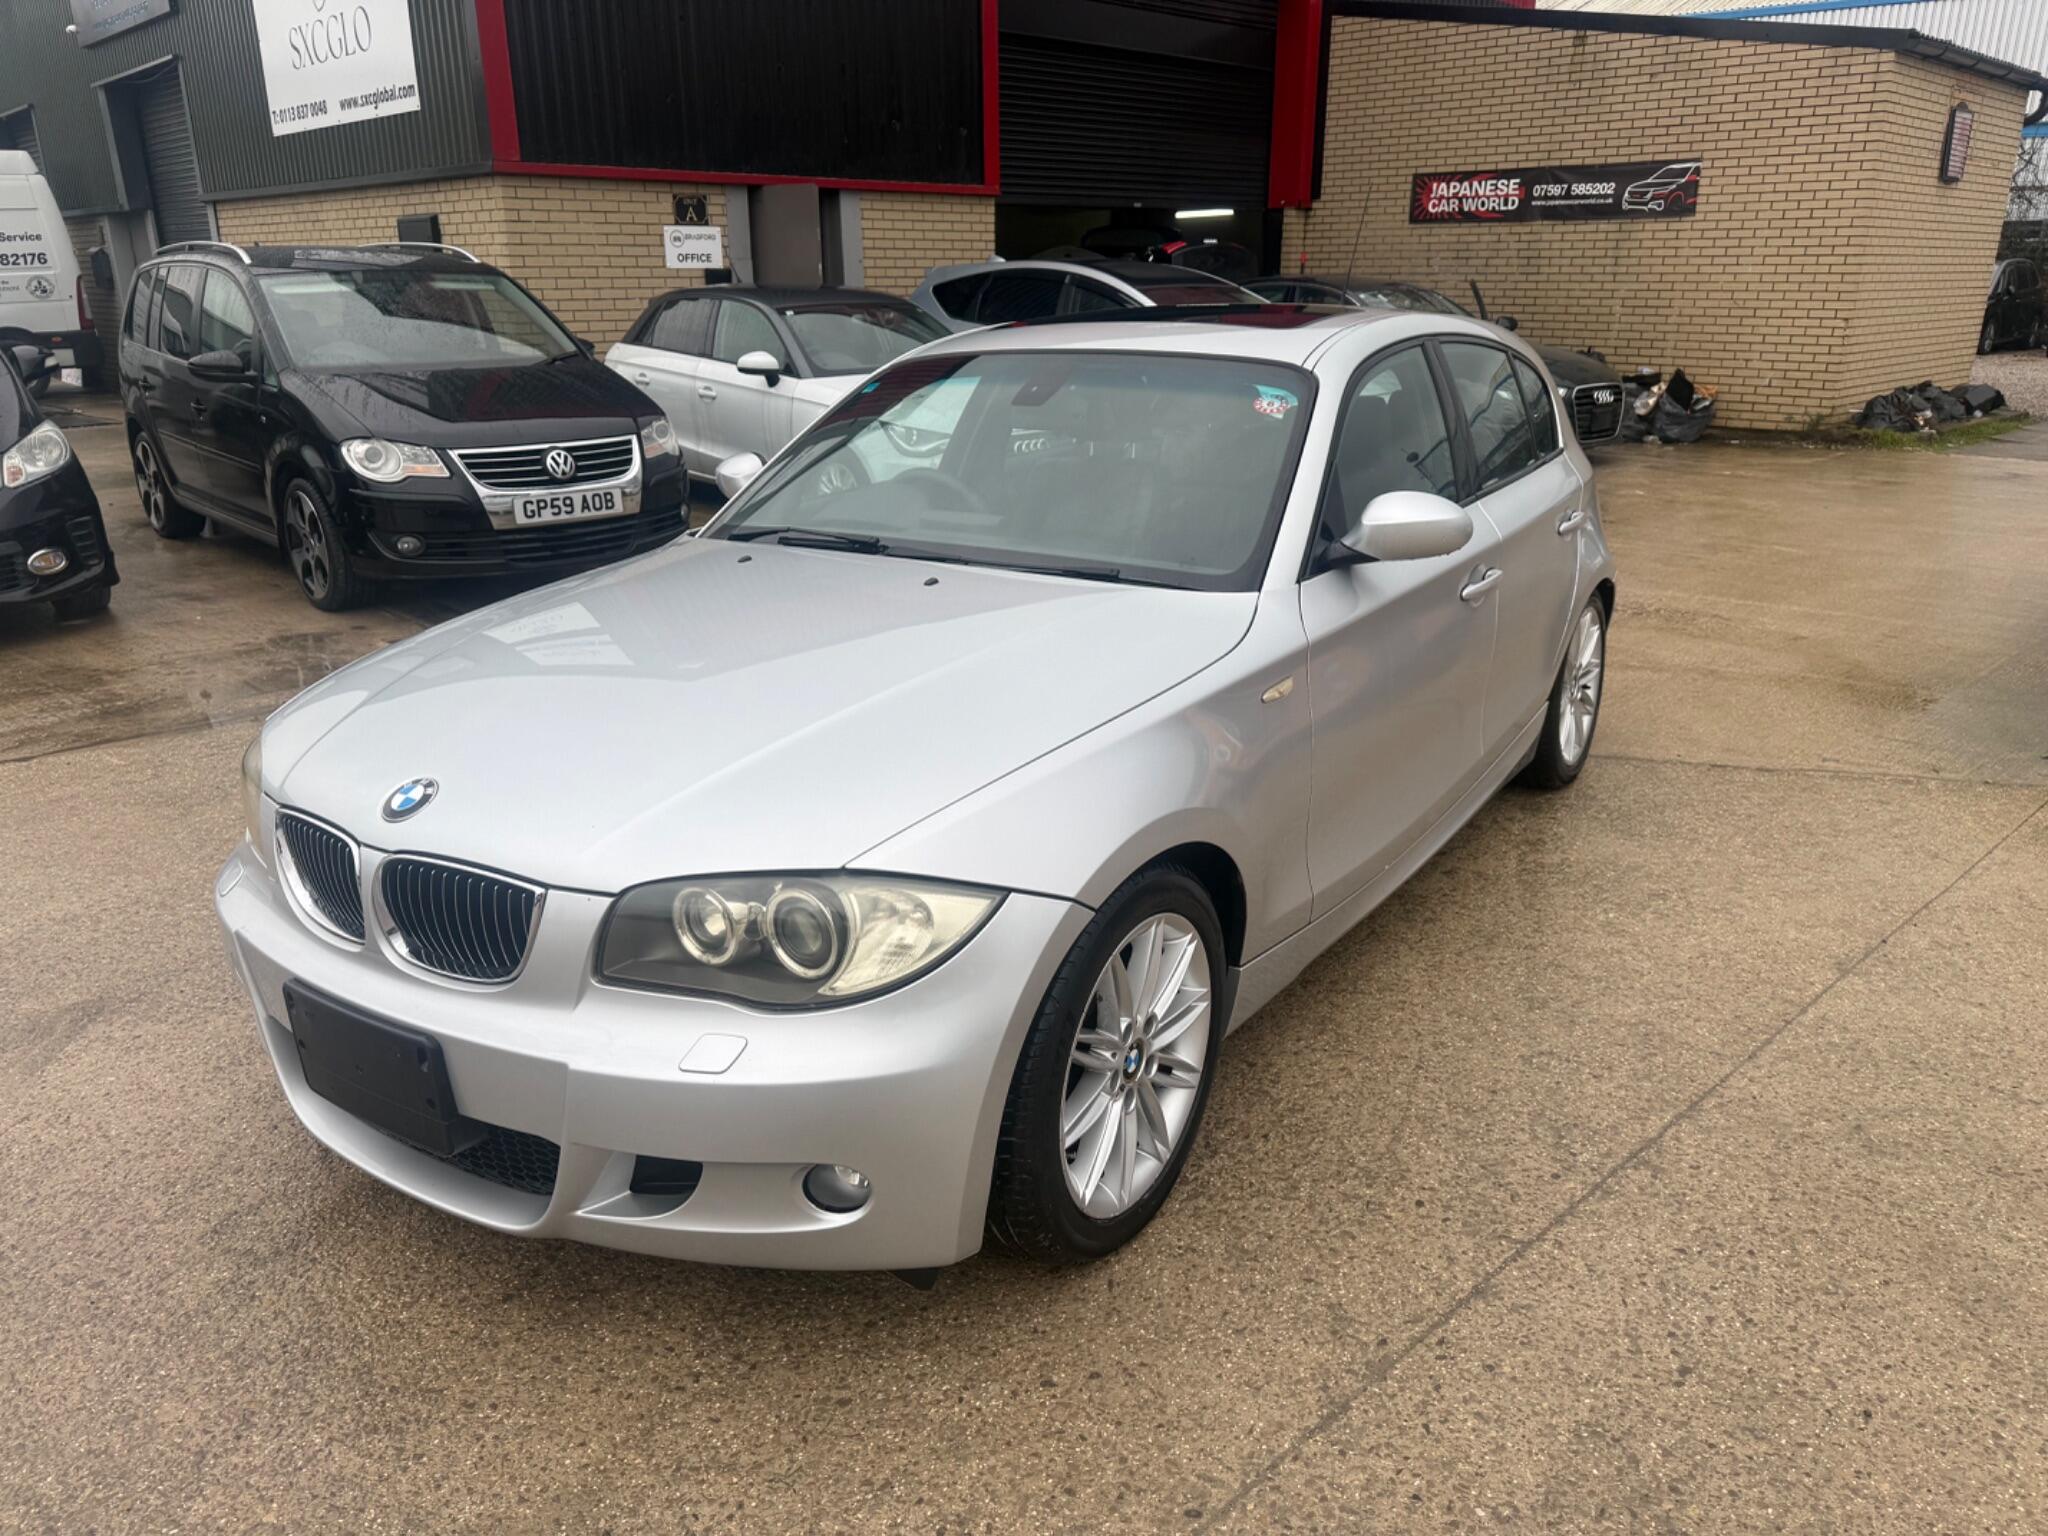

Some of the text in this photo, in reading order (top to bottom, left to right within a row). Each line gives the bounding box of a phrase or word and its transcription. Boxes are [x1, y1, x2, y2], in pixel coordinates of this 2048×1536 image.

[288, 5, 372, 70] SXCGLO
[339, 83, 416, 110] www.sxcglobal.com
[1430, 178, 1521, 198] JAPANESE
[1532, 182, 1616, 197] 07597 585202
[1427, 196, 1520, 213] CAR WORLD
[686, 205, 697, 222] A
[0, 231, 42, 242] Service
[0, 252, 48, 266] 82176
[677, 253, 712, 263] OFFICE
[523, 492, 615, 519] GP59 AOB
